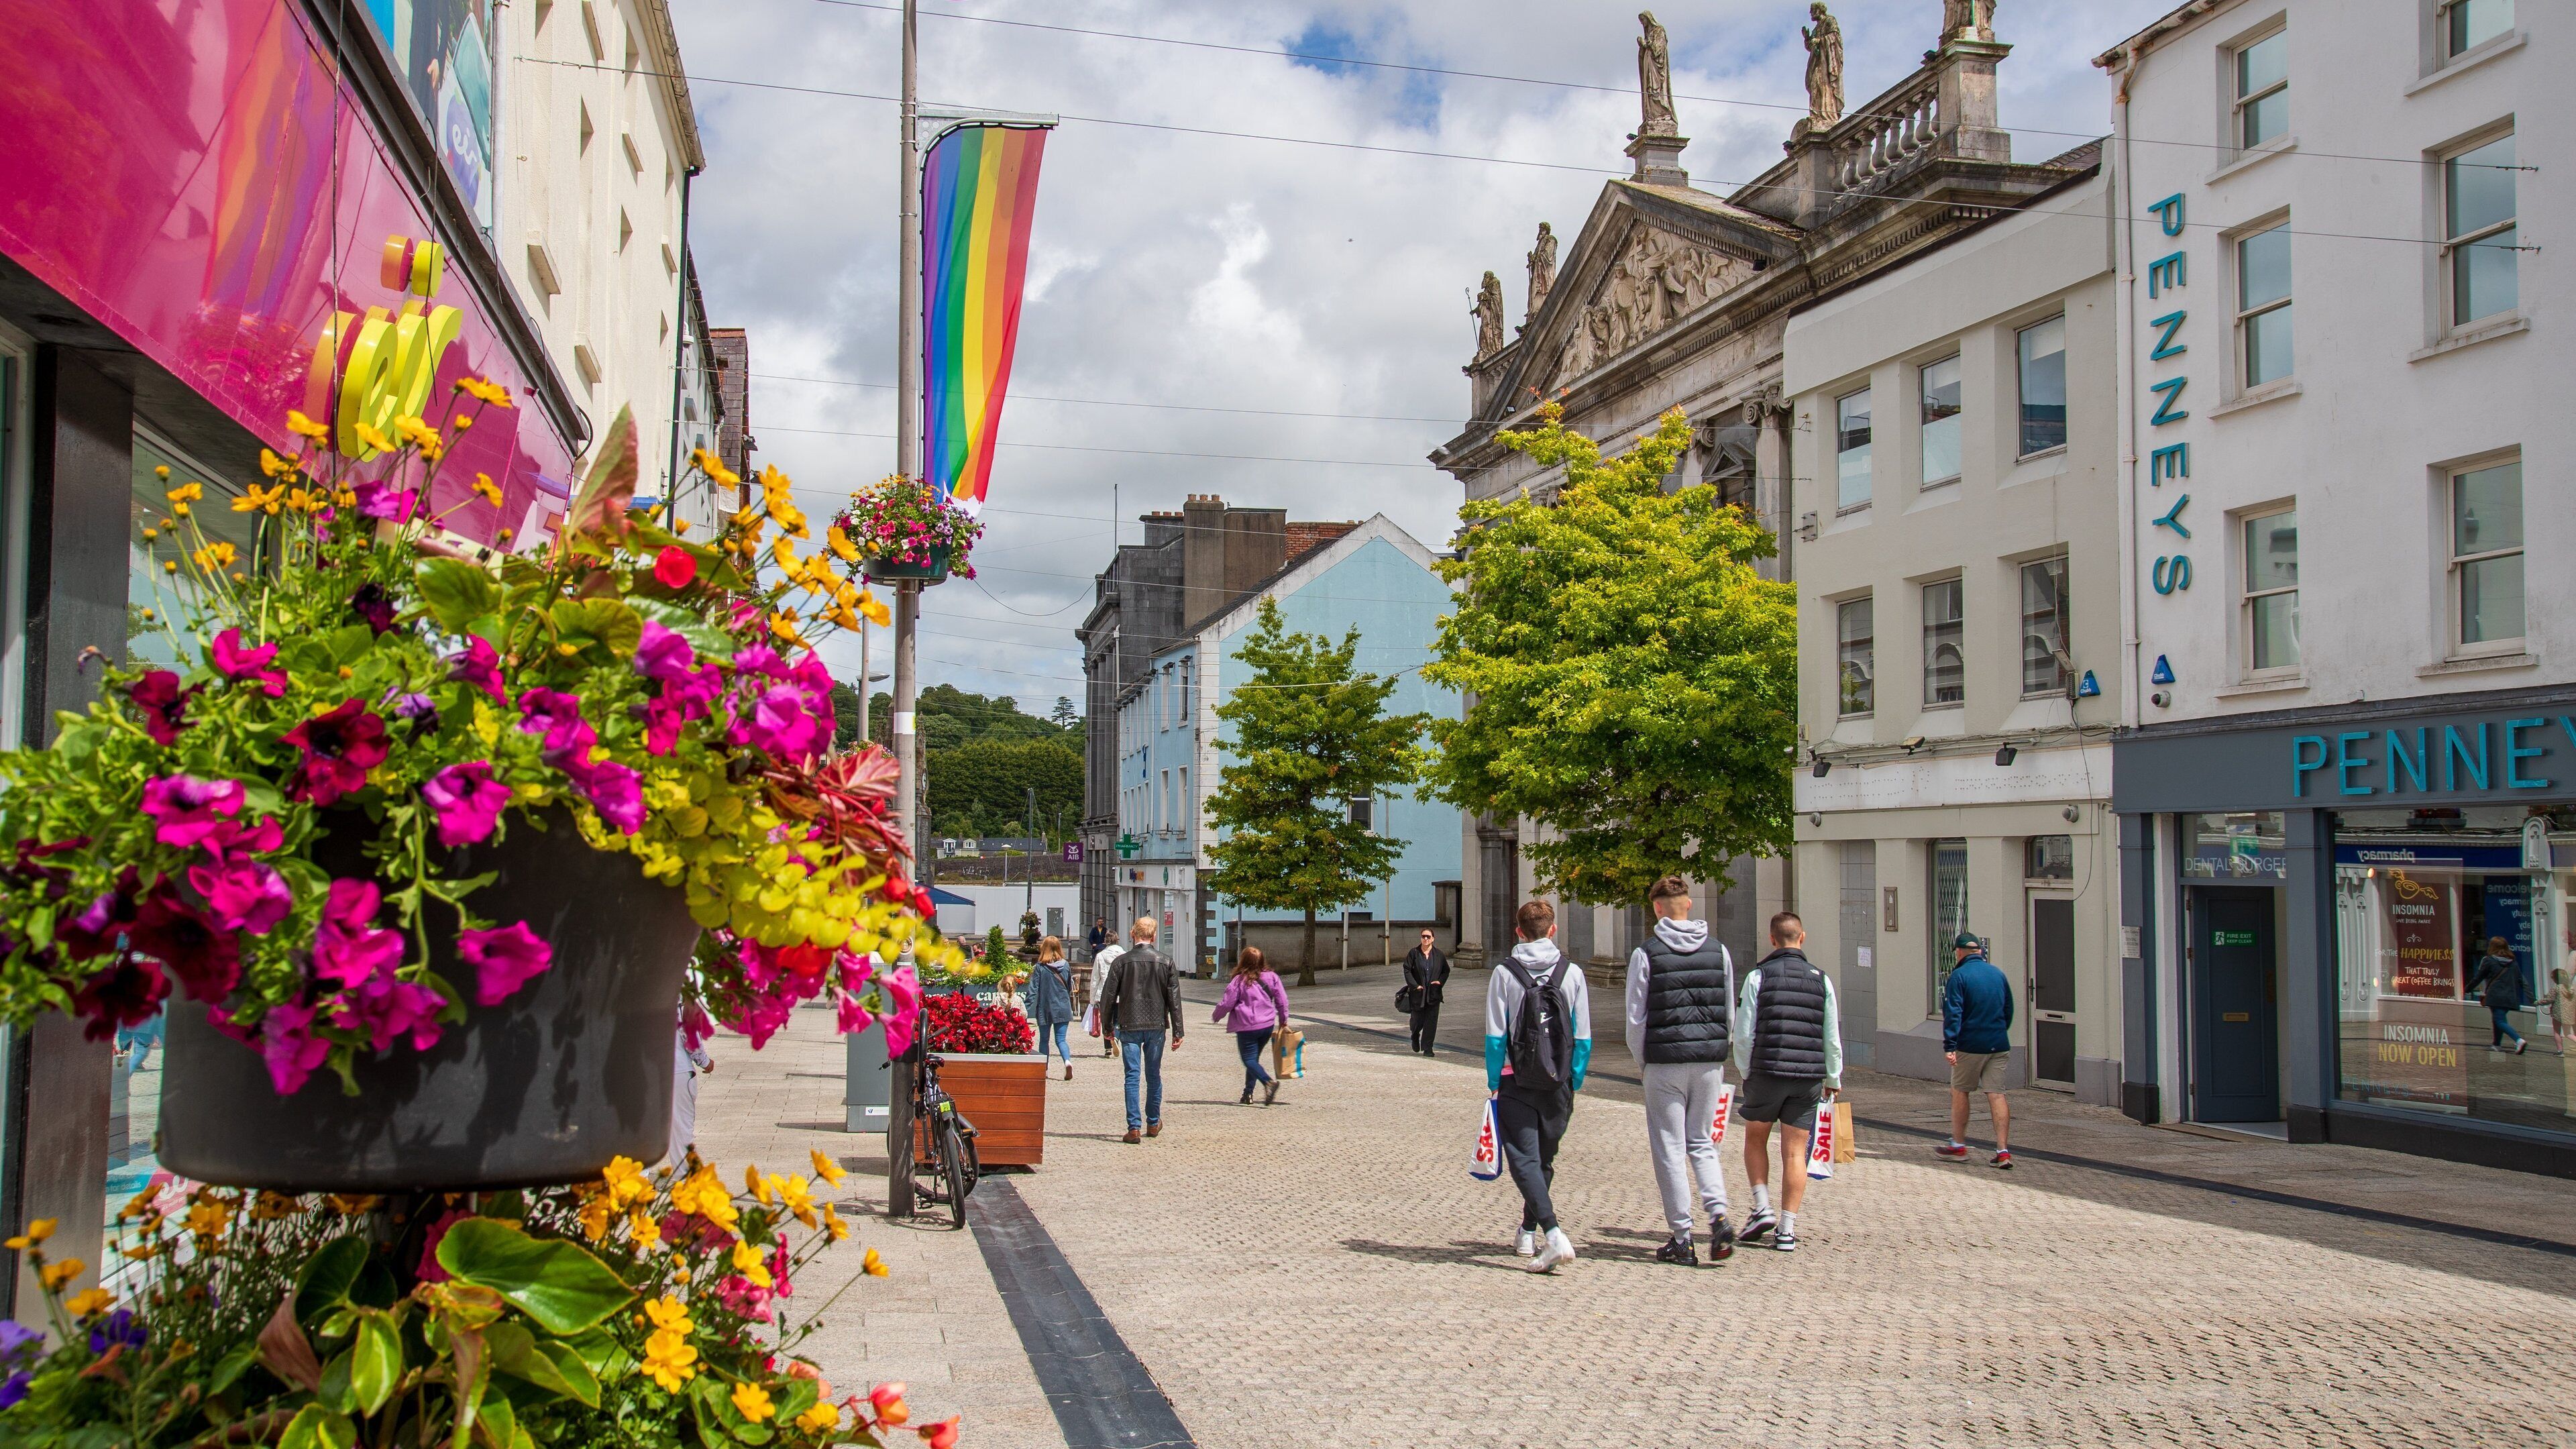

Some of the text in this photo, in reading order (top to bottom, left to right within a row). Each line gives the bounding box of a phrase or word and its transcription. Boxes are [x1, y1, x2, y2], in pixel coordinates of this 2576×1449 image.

[2148, 193, 2192, 596] PENNEYS
[2185, 857, 2231, 871] DENTAL
[2392, 904, 2435, 916] INSOMNIA
[2375, 948, 2455, 961] FOR THE HAPPINESS
[2404, 967, 2440, 976] THAT TRULY
[2411, 977, 2431, 986] COFFEE
[2433, 978, 2455, 987] BRINGS
[2384, 1024, 2449, 1045] INSOMNIA
[2378, 1043, 2457, 1067] NOW OPEN
[2343, 1074, 2410, 1098] PENNEYS
[1711, 1093, 1729, 1143] SALE
[1813, 1111, 1831, 1163] SALE
